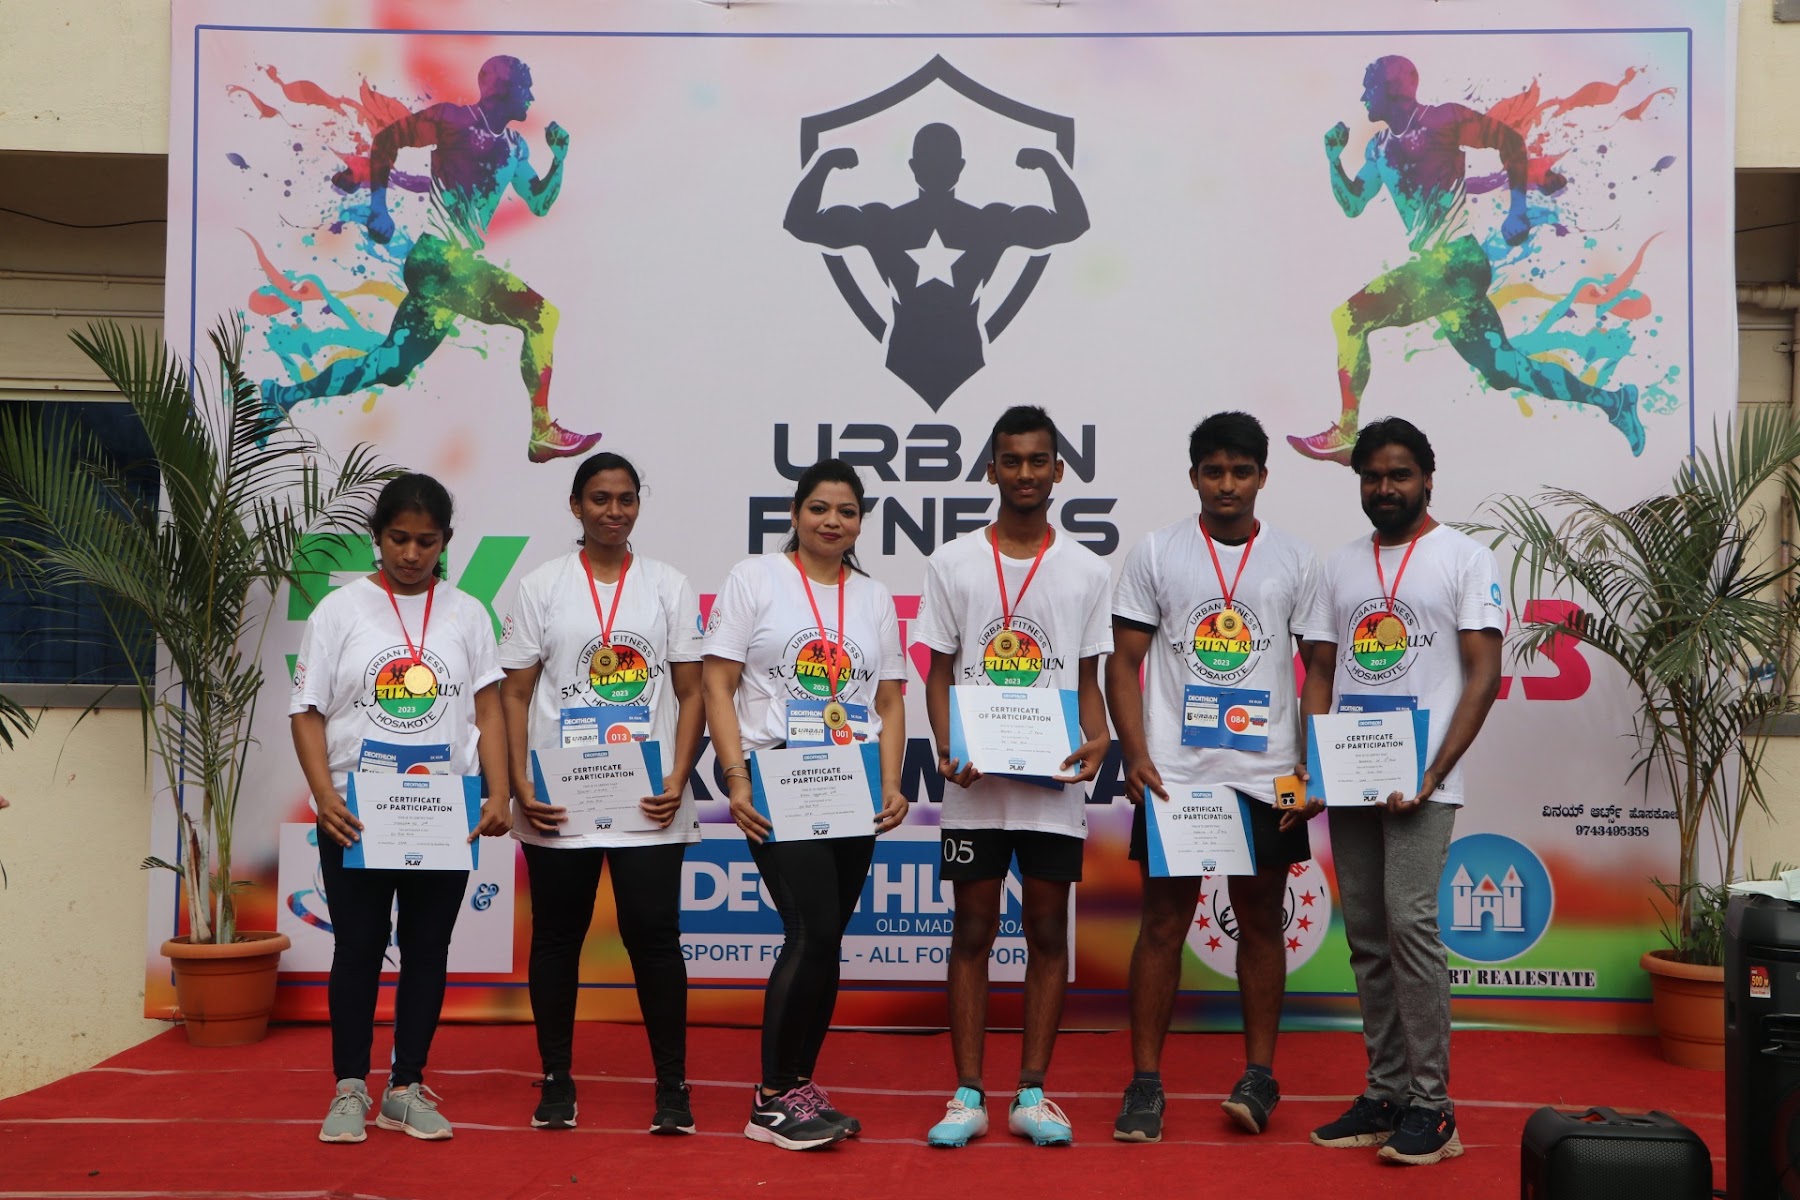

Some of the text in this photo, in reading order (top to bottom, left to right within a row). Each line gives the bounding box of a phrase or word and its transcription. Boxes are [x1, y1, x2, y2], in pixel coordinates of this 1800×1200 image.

[748, 496, 1121, 556] FNES
[1189, 602, 1222, 626] URBAN
[1379, 601, 1414, 626] FNESS
[1012, 620, 1047, 649] FITNESS
[581, 634, 652, 665] URBA FITNESS
[791, 631, 860, 660] URBAN FITESS
[1187, 639, 1230, 656] FUN
[1348, 640, 1387, 662] FUN
[369, 649, 445, 677] URBAN FNESS
[978, 656, 1022, 677] FUN
[1026, 654, 1066, 671] RUN
[1212, 658, 1230, 666] 2023
[1370, 658, 1387, 666] 2023
[768, 664, 786, 680] 5K
[788, 663, 829, 680] FUN
[1192, 662, 1249, 682] HOSAKOTE
[1351, 662, 1406, 681] HOSAKOTE
[561, 681, 582, 700] 5K
[585, 670, 627, 694] FUN
[813, 683, 830, 692] 2023
[591, 694, 648, 707] HOOTE
[990, 706, 1040, 714] CERTIFICATE
[376, 711, 437, 729] HOSAKOTE
[564, 717, 596, 725] DECATHLON
[991, 713, 1051, 722] PARTICIPATION
[1230, 715, 1246, 724] 084
[611, 733, 627, 741] 013
[835, 730, 849, 738] 001
[1346, 733, 1393, 742] CERTIFICATE
[1347, 741, 1403, 749] PARTICIPATION
[572, 764, 622, 774] CERTIFICATE
[791, 767, 841, 776] CERTIFICATE
[574, 771, 634, 781] PARTICIPATION
[793, 774, 853, 784] PARTICIPATION
[389, 796, 441, 804] CERTIFICATE
[390, 804, 453, 812] PARTICIPATION
[1575, 825, 1649, 837] 9743495358
[943, 838, 975, 864] 05
[876, 919, 910, 933] OLD
[915, 919, 954, 933] MAD
[681, 944, 754, 962] SPORT
[760, 945, 783, 962] FO
[869, 946, 909, 963] ALL
[1448, 969, 1595, 987] RT REALESTATE
